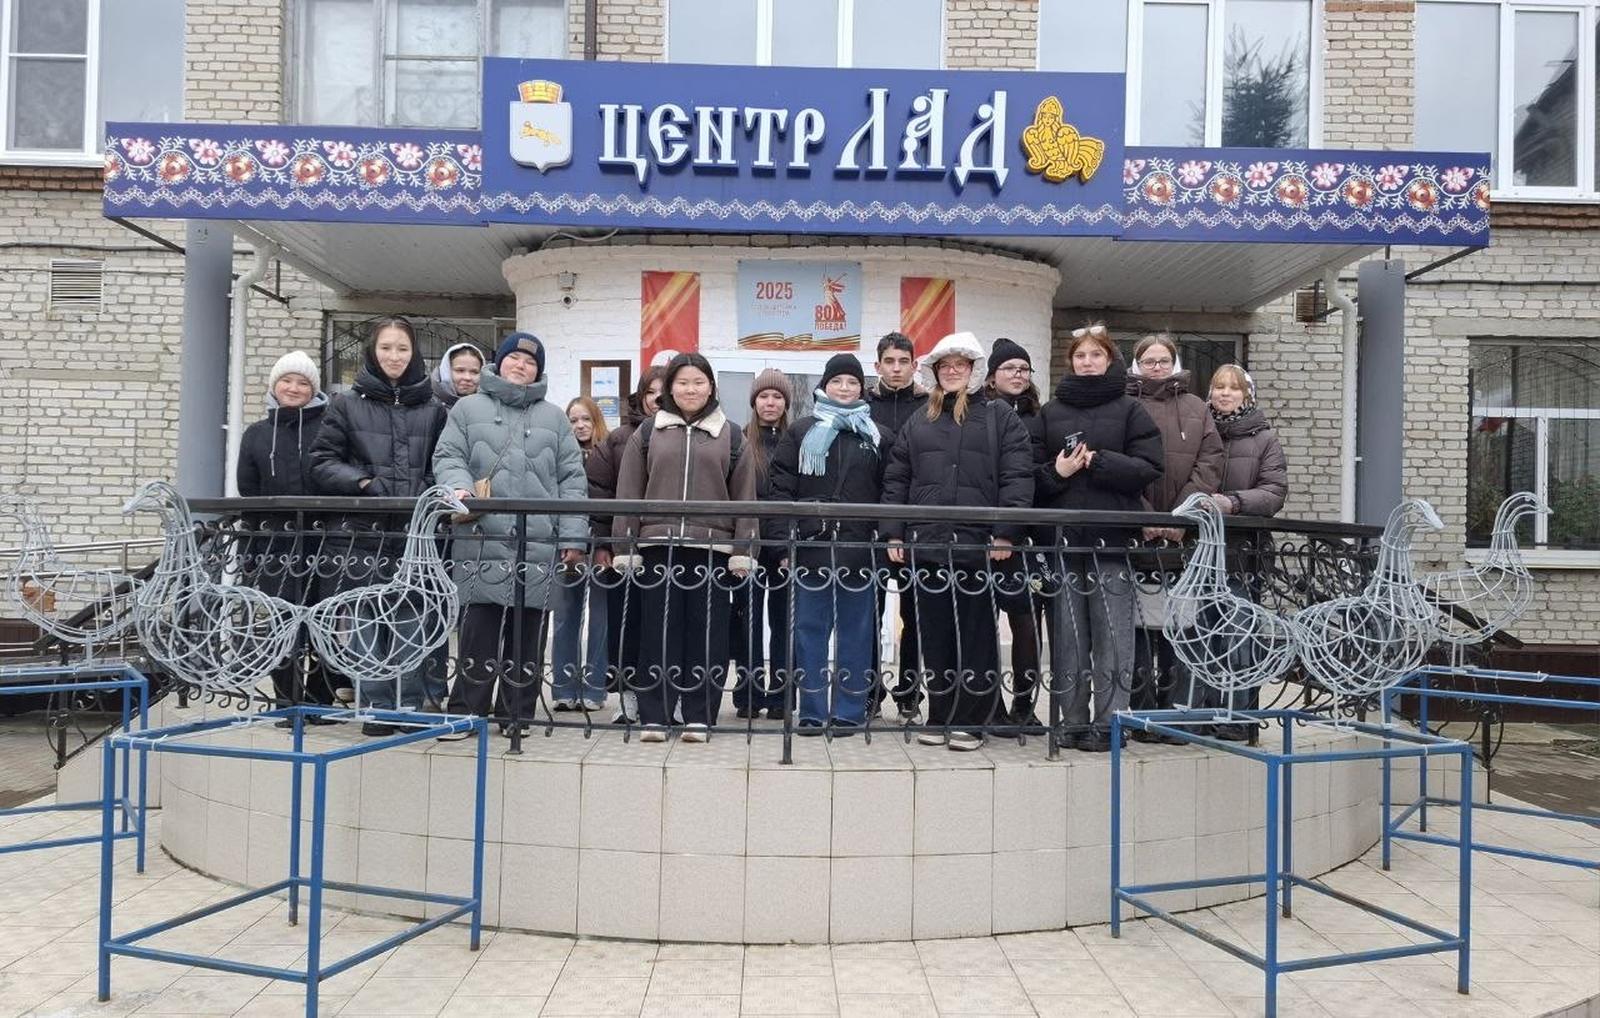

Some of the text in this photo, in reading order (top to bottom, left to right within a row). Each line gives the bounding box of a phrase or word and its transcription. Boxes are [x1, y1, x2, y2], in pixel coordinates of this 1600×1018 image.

[598, 88, 1008, 189] ЦЕНТР ЛАД
[756, 282, 793, 300] 2025
[815, 305, 833, 321] 80
[815, 321, 847, 331] ПОБЕДА!
